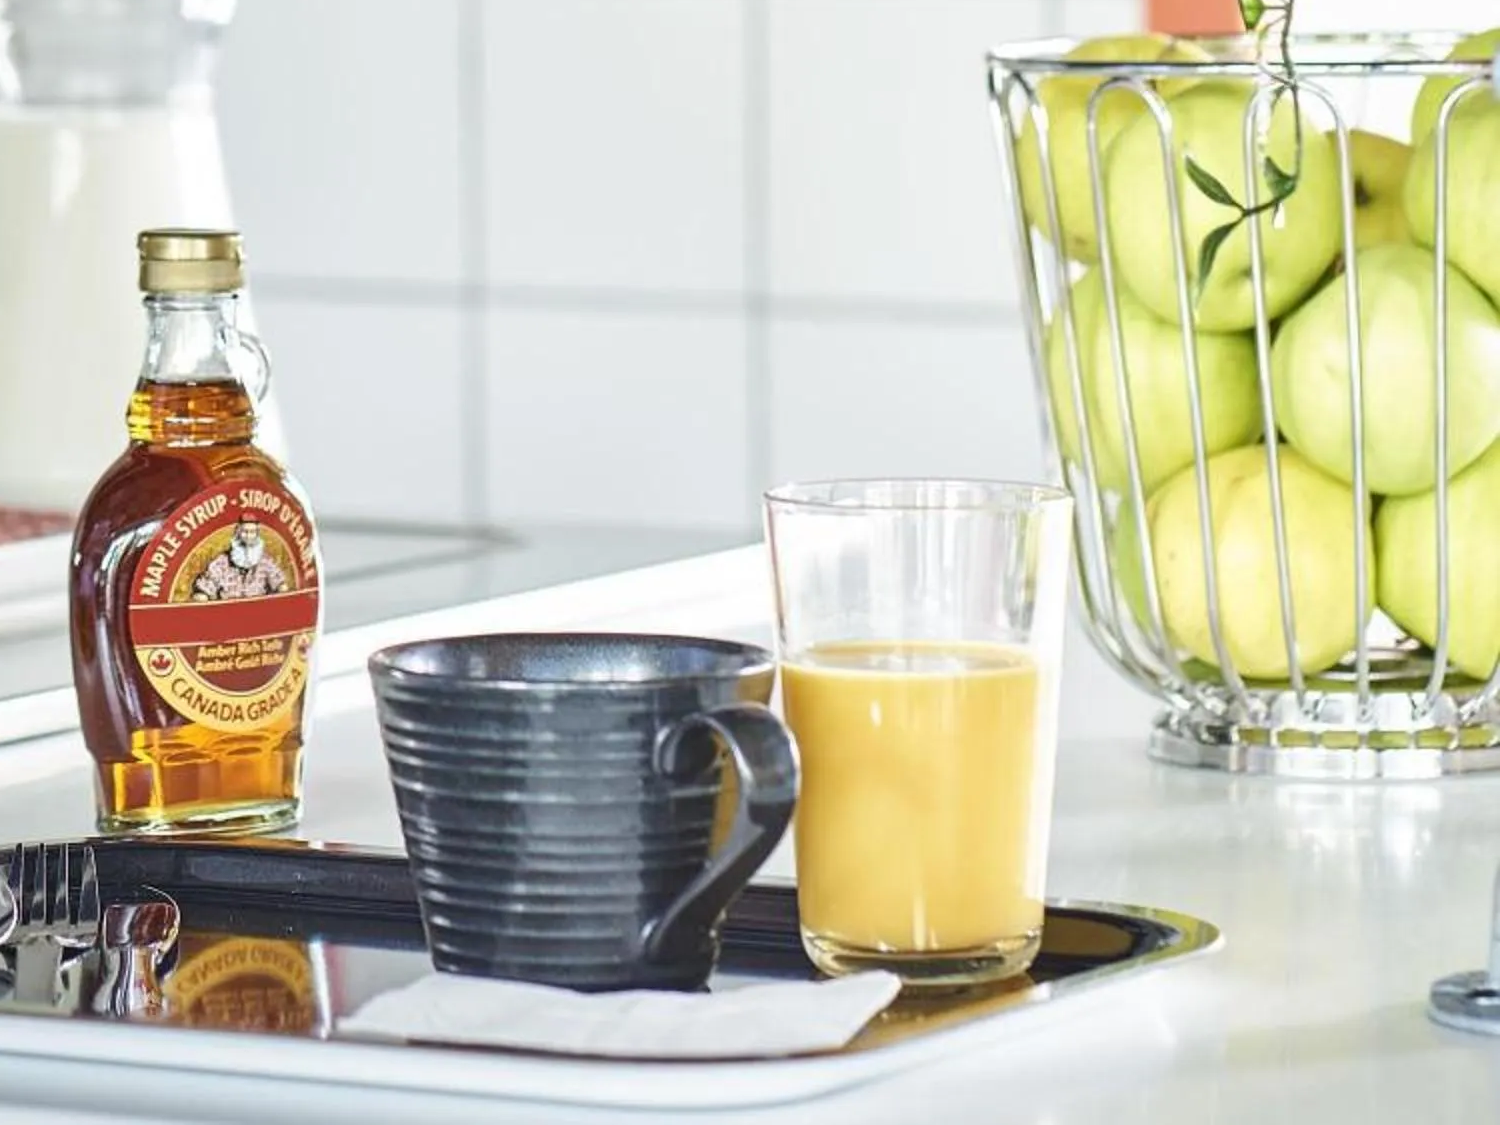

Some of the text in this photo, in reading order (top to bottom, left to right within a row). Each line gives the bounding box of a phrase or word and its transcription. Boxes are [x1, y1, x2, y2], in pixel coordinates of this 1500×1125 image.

[141, 532, 182, 597] MAPLE
[175, 494, 228, 539] SYRUP
[240, 488, 281, 514] SIROP
[198, 645, 237, 658] Amber
[171, 677, 245, 723] CANADA
[246, 679, 293, 721] GRADE
